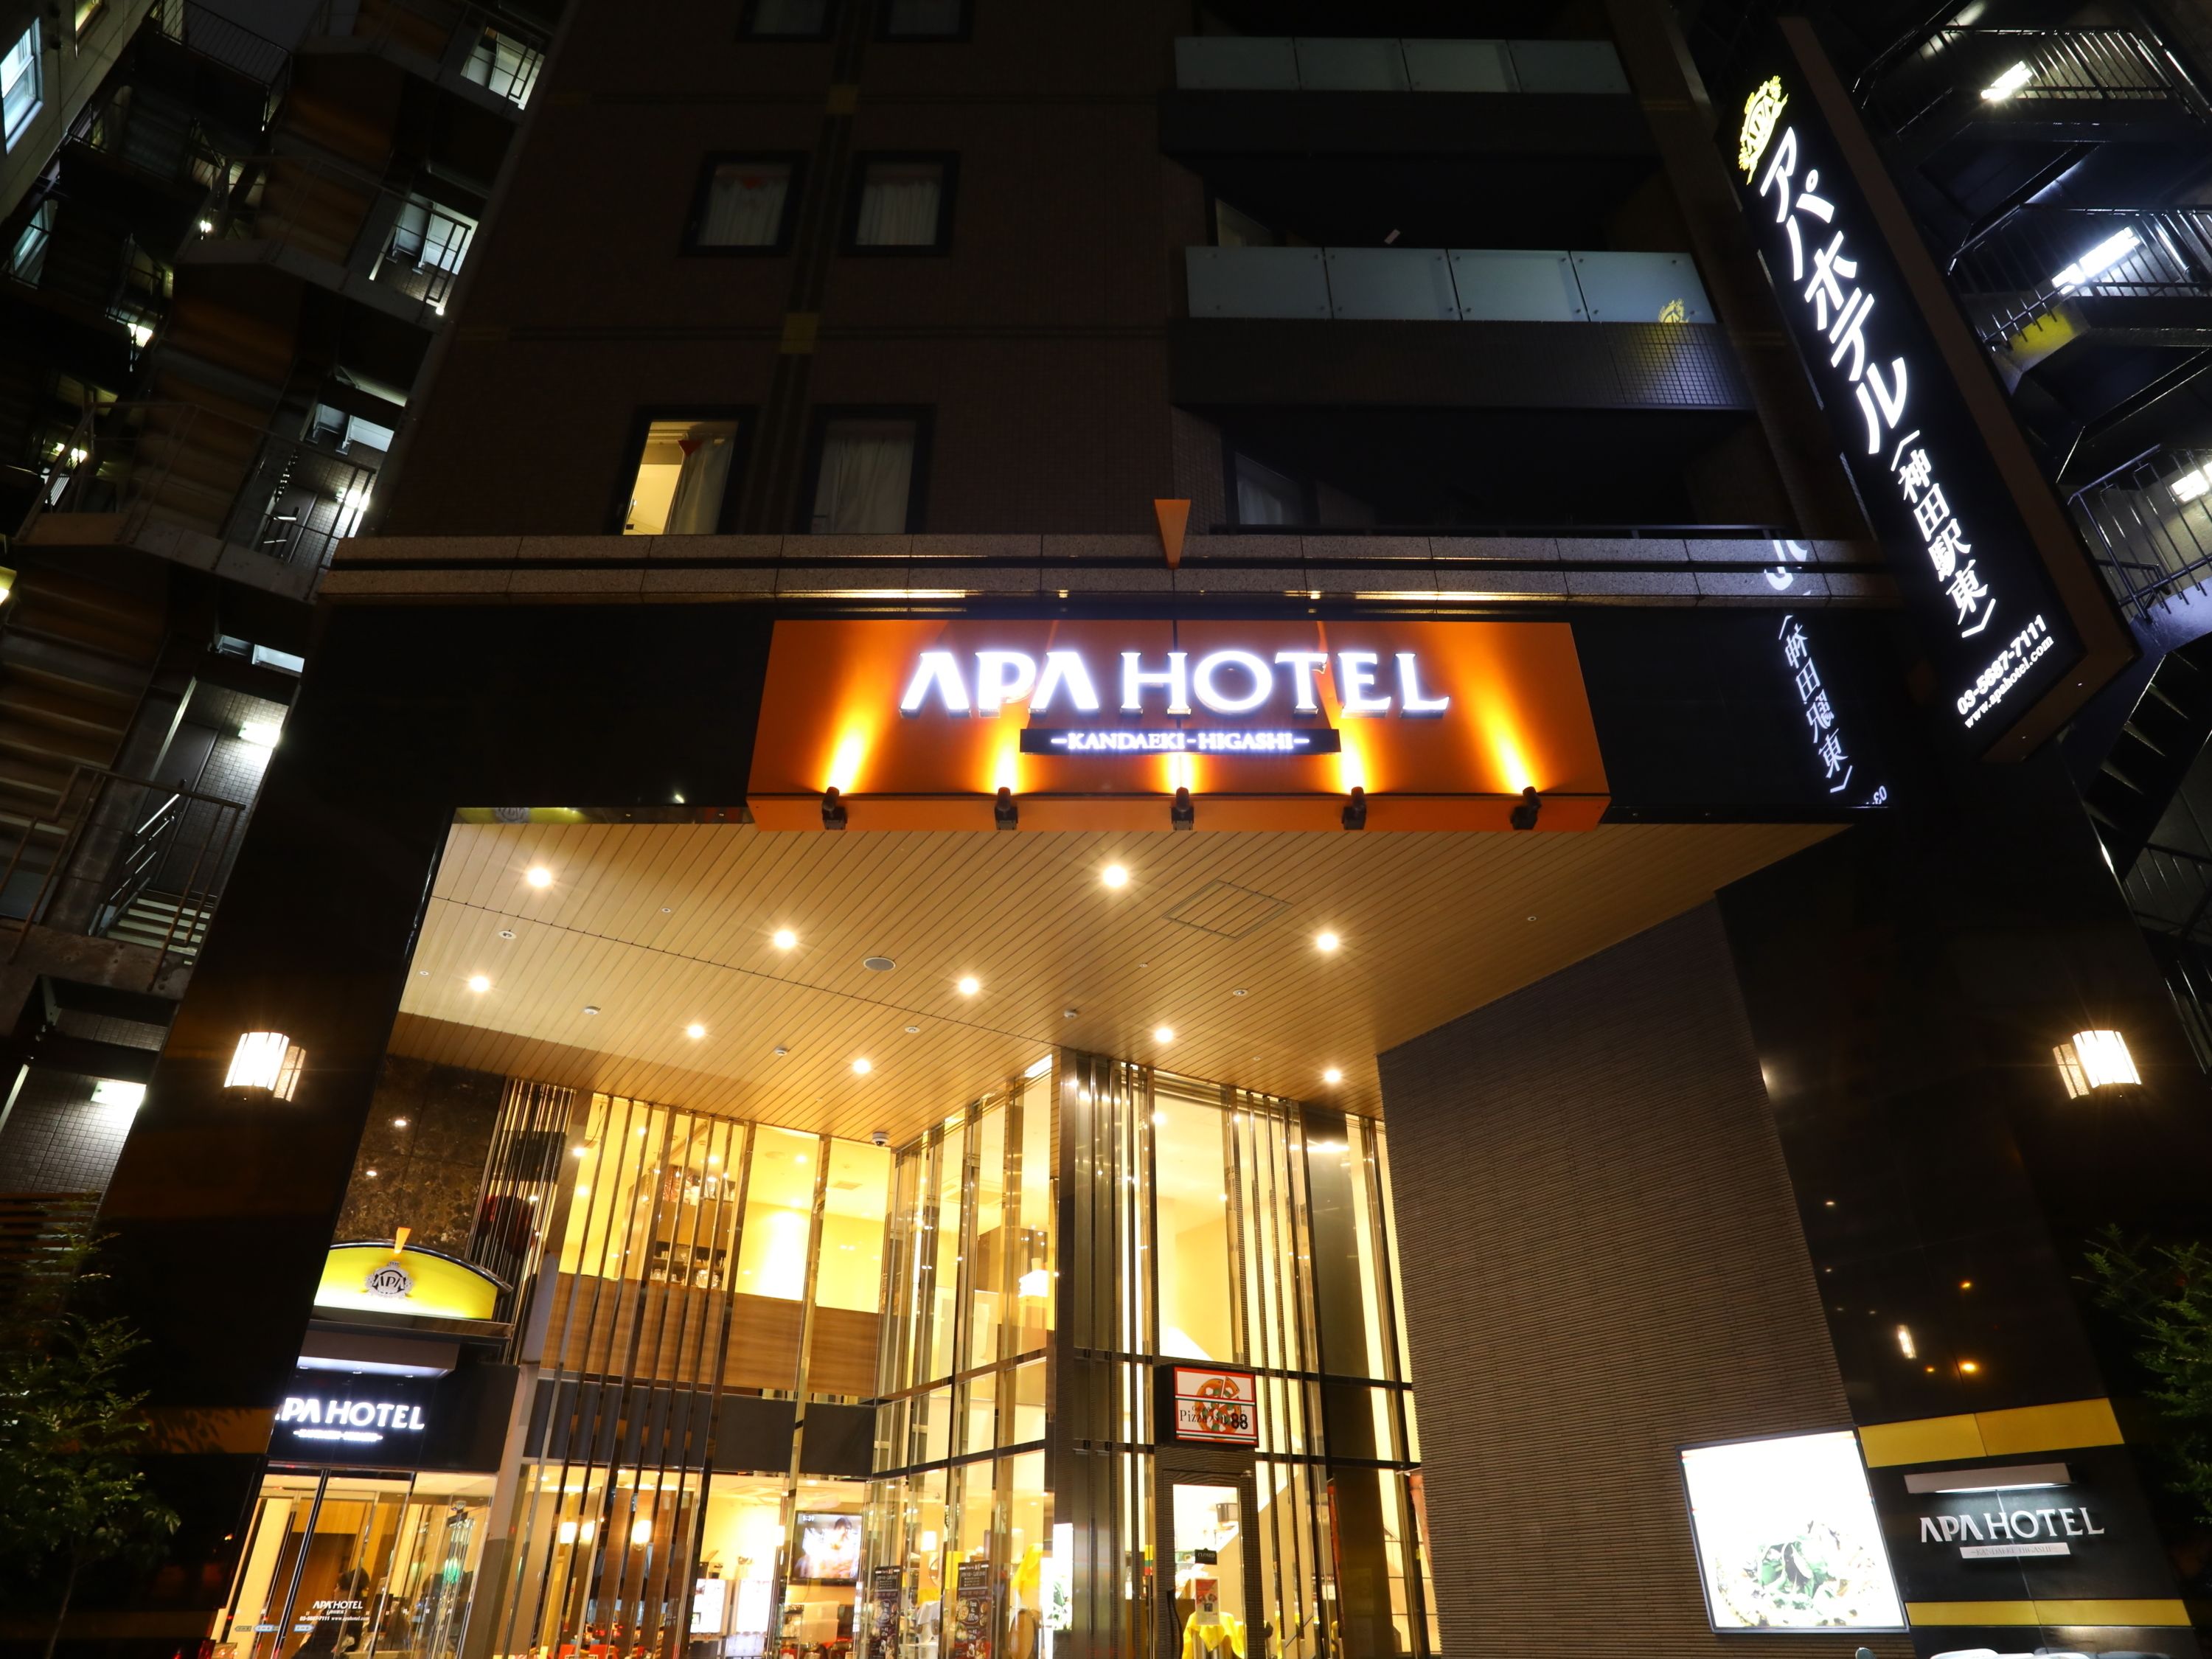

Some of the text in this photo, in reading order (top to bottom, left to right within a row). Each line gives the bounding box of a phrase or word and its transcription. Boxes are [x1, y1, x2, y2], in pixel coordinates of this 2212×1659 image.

[1760, 126, 1907, 455] アパホテル
[899, 650, 1450, 717] APA HOTEL
[1964, 636, 2054, 728] www.apahotel.com
[372, 1274, 407, 1290] APA
[275, 1397, 425, 1430] PA HOTEL
[1919, 1507, 2105, 1543] APA HOTEL
[313, 1600, 363, 1609] APA HOTEL
